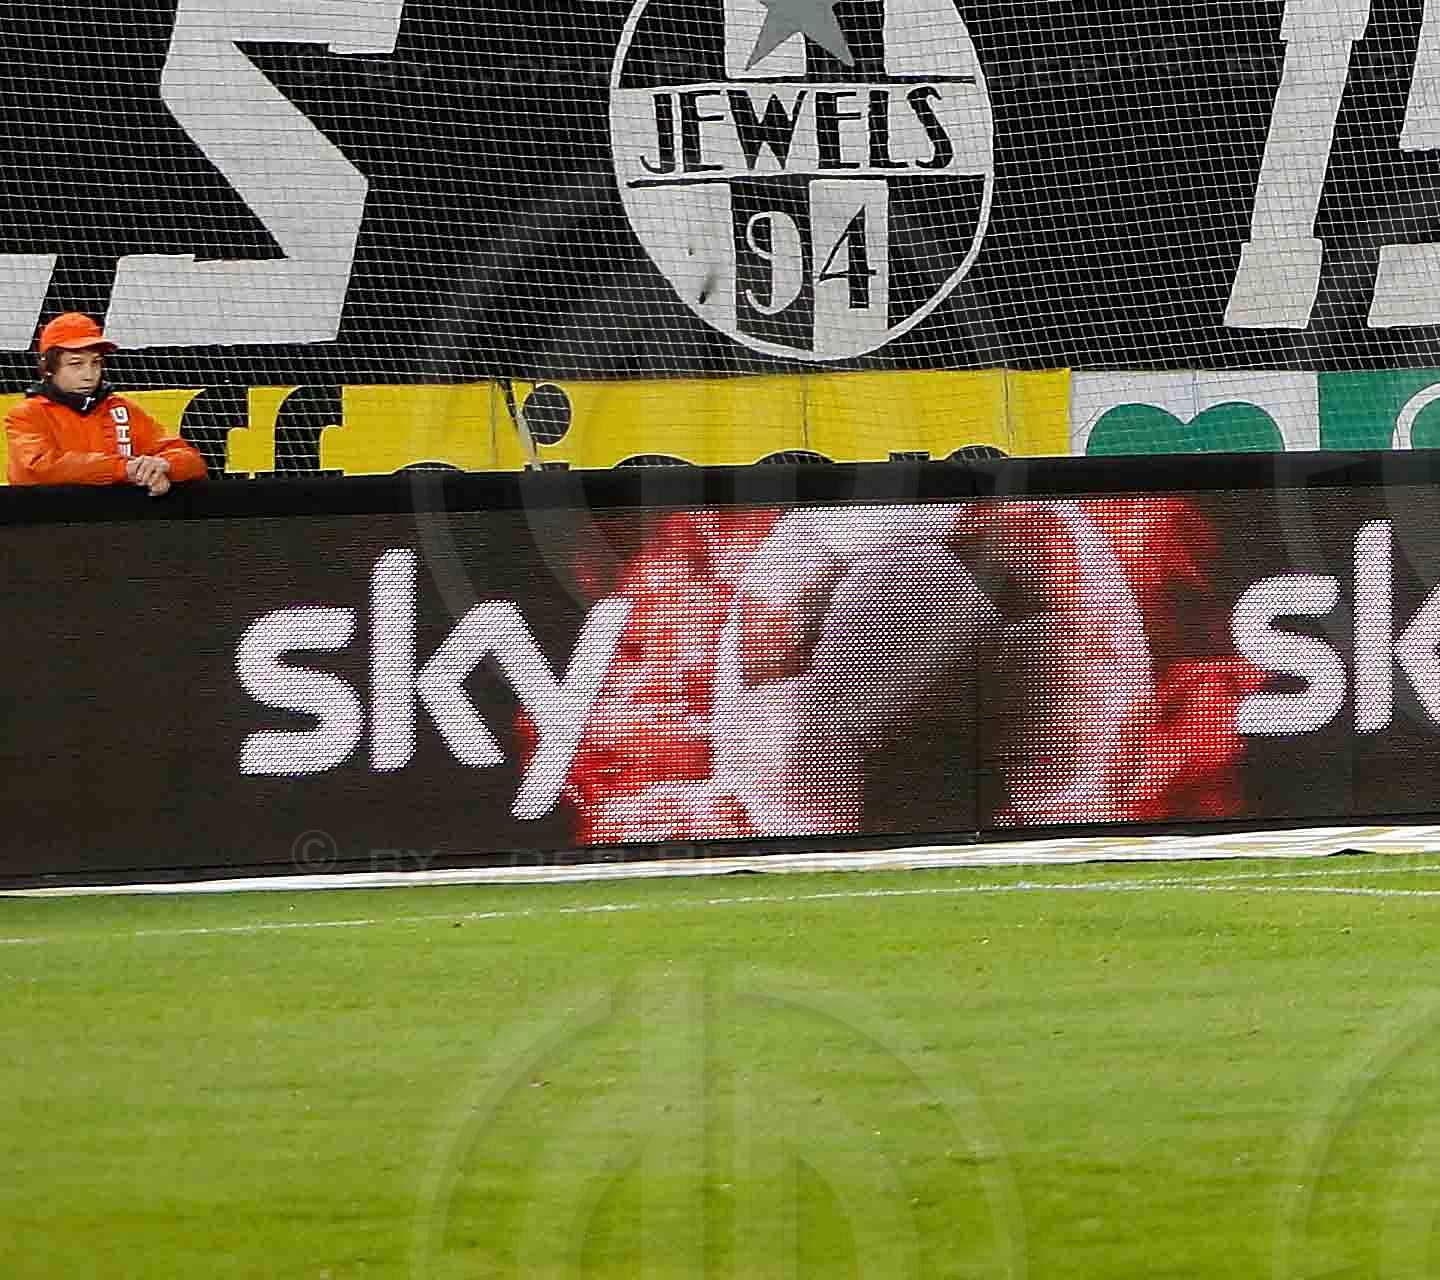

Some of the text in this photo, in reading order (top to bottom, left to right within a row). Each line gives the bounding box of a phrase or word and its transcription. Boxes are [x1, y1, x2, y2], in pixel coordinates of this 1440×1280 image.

[640, 86, 956, 175] JEWELS
[742, 206, 880, 313] 94
[235, 547, 632, 821] sky
